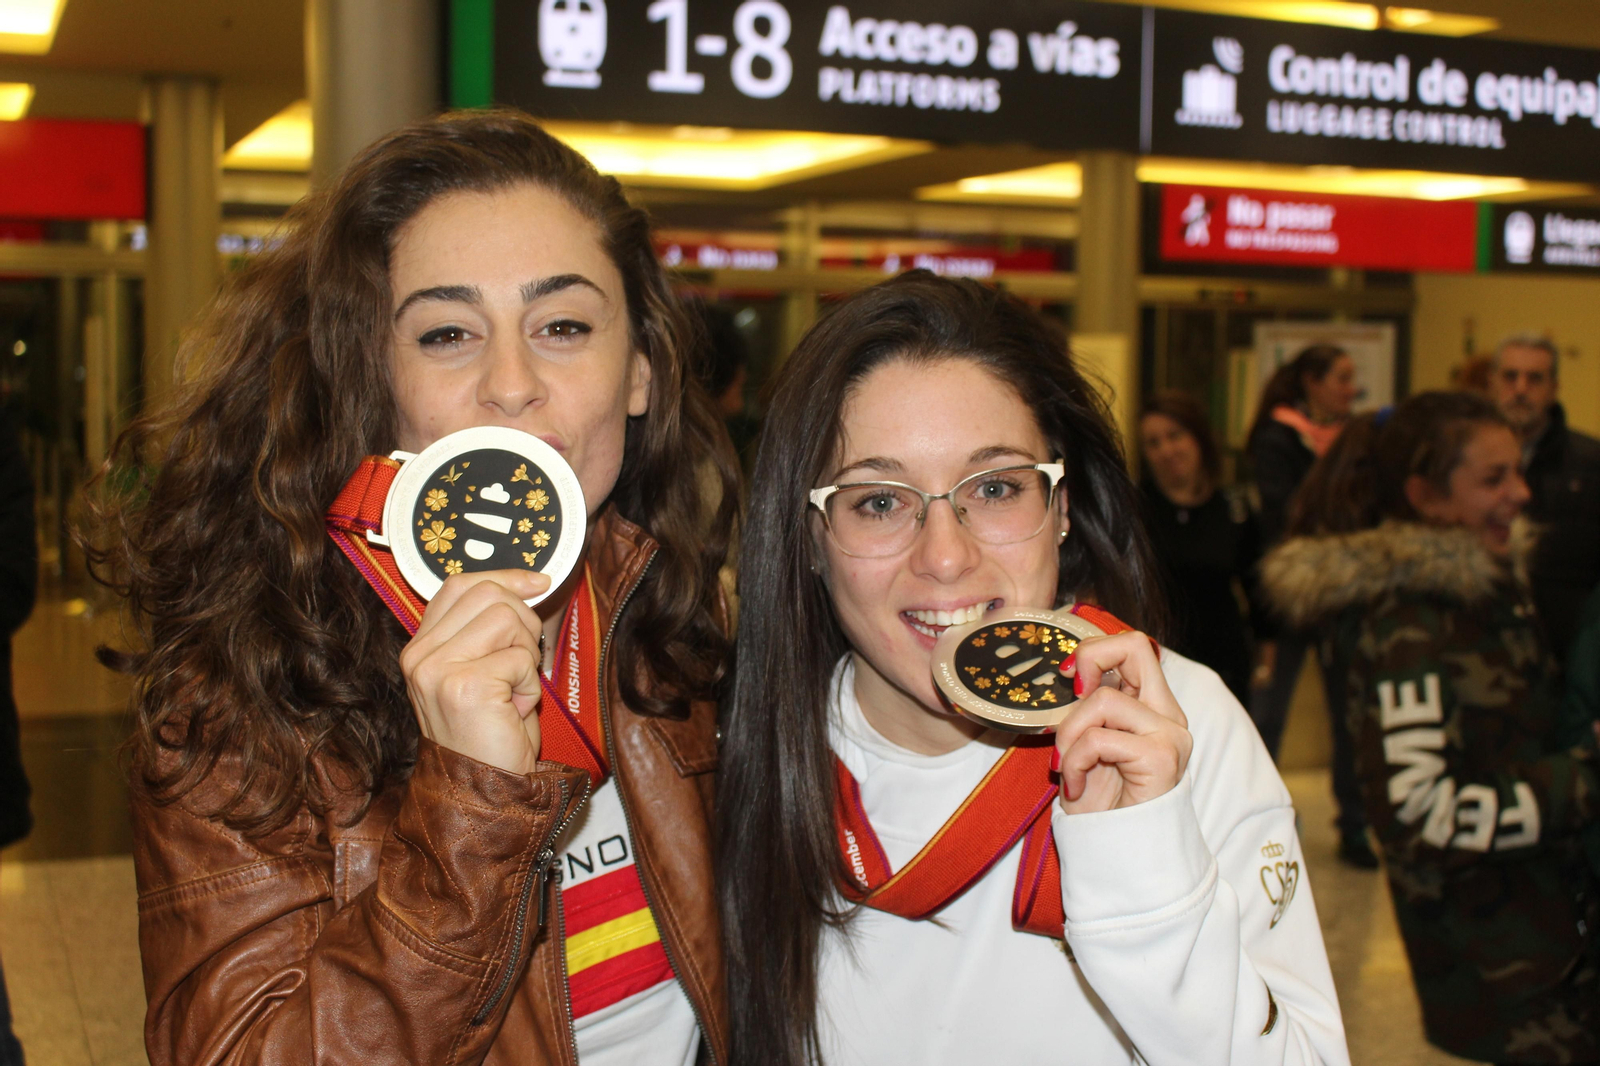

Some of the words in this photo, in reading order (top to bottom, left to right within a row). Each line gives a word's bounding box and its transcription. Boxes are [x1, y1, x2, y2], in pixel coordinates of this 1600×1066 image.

[647, 0, 794, 99] 1-8
[818, 4, 978, 67] Acceso
[986, 28, 1019, 70] a
[1027, 20, 1121, 79] vías
[818, 66, 1001, 113] PLATFORMS
[1267, 44, 1410, 103] Control
[1417, 57, 1468, 108] de
[1266, 98, 1393, 140] LUGGAGE
[1393, 109, 1507, 149] CONTROL
[568, 652, 581, 722] IONSHIP
